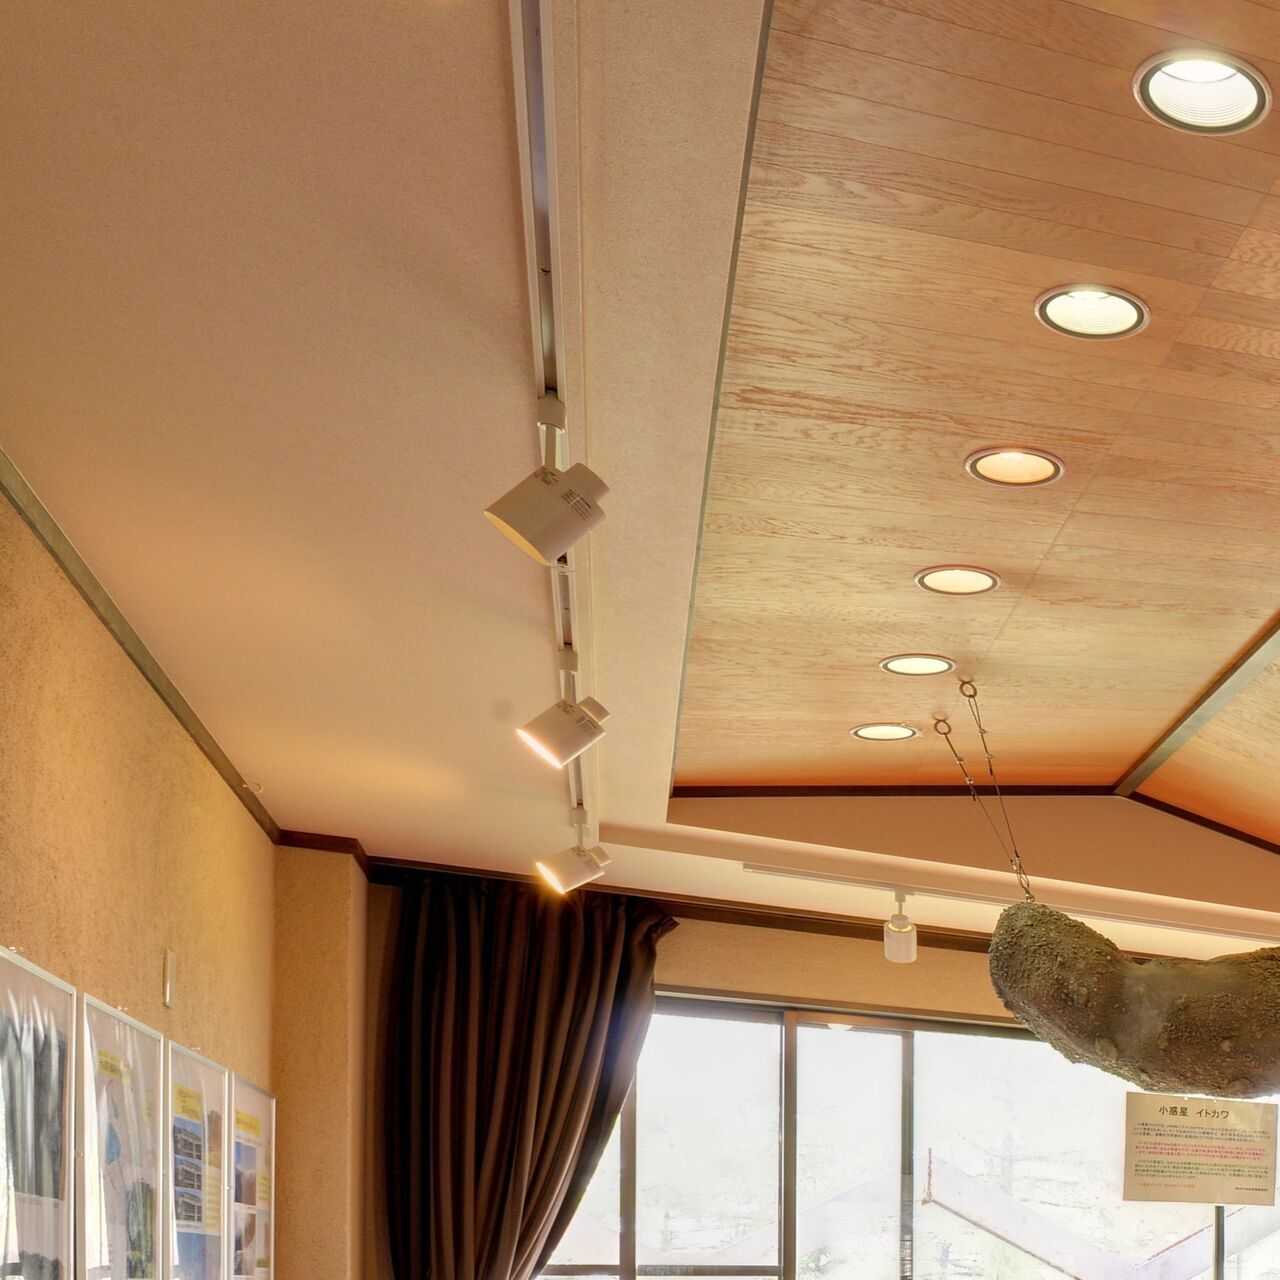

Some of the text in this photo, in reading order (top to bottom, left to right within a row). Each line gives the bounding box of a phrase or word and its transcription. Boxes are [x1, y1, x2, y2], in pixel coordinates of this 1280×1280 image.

[1158, 1105, 1230, 1120] 小惑星 イトカワ
